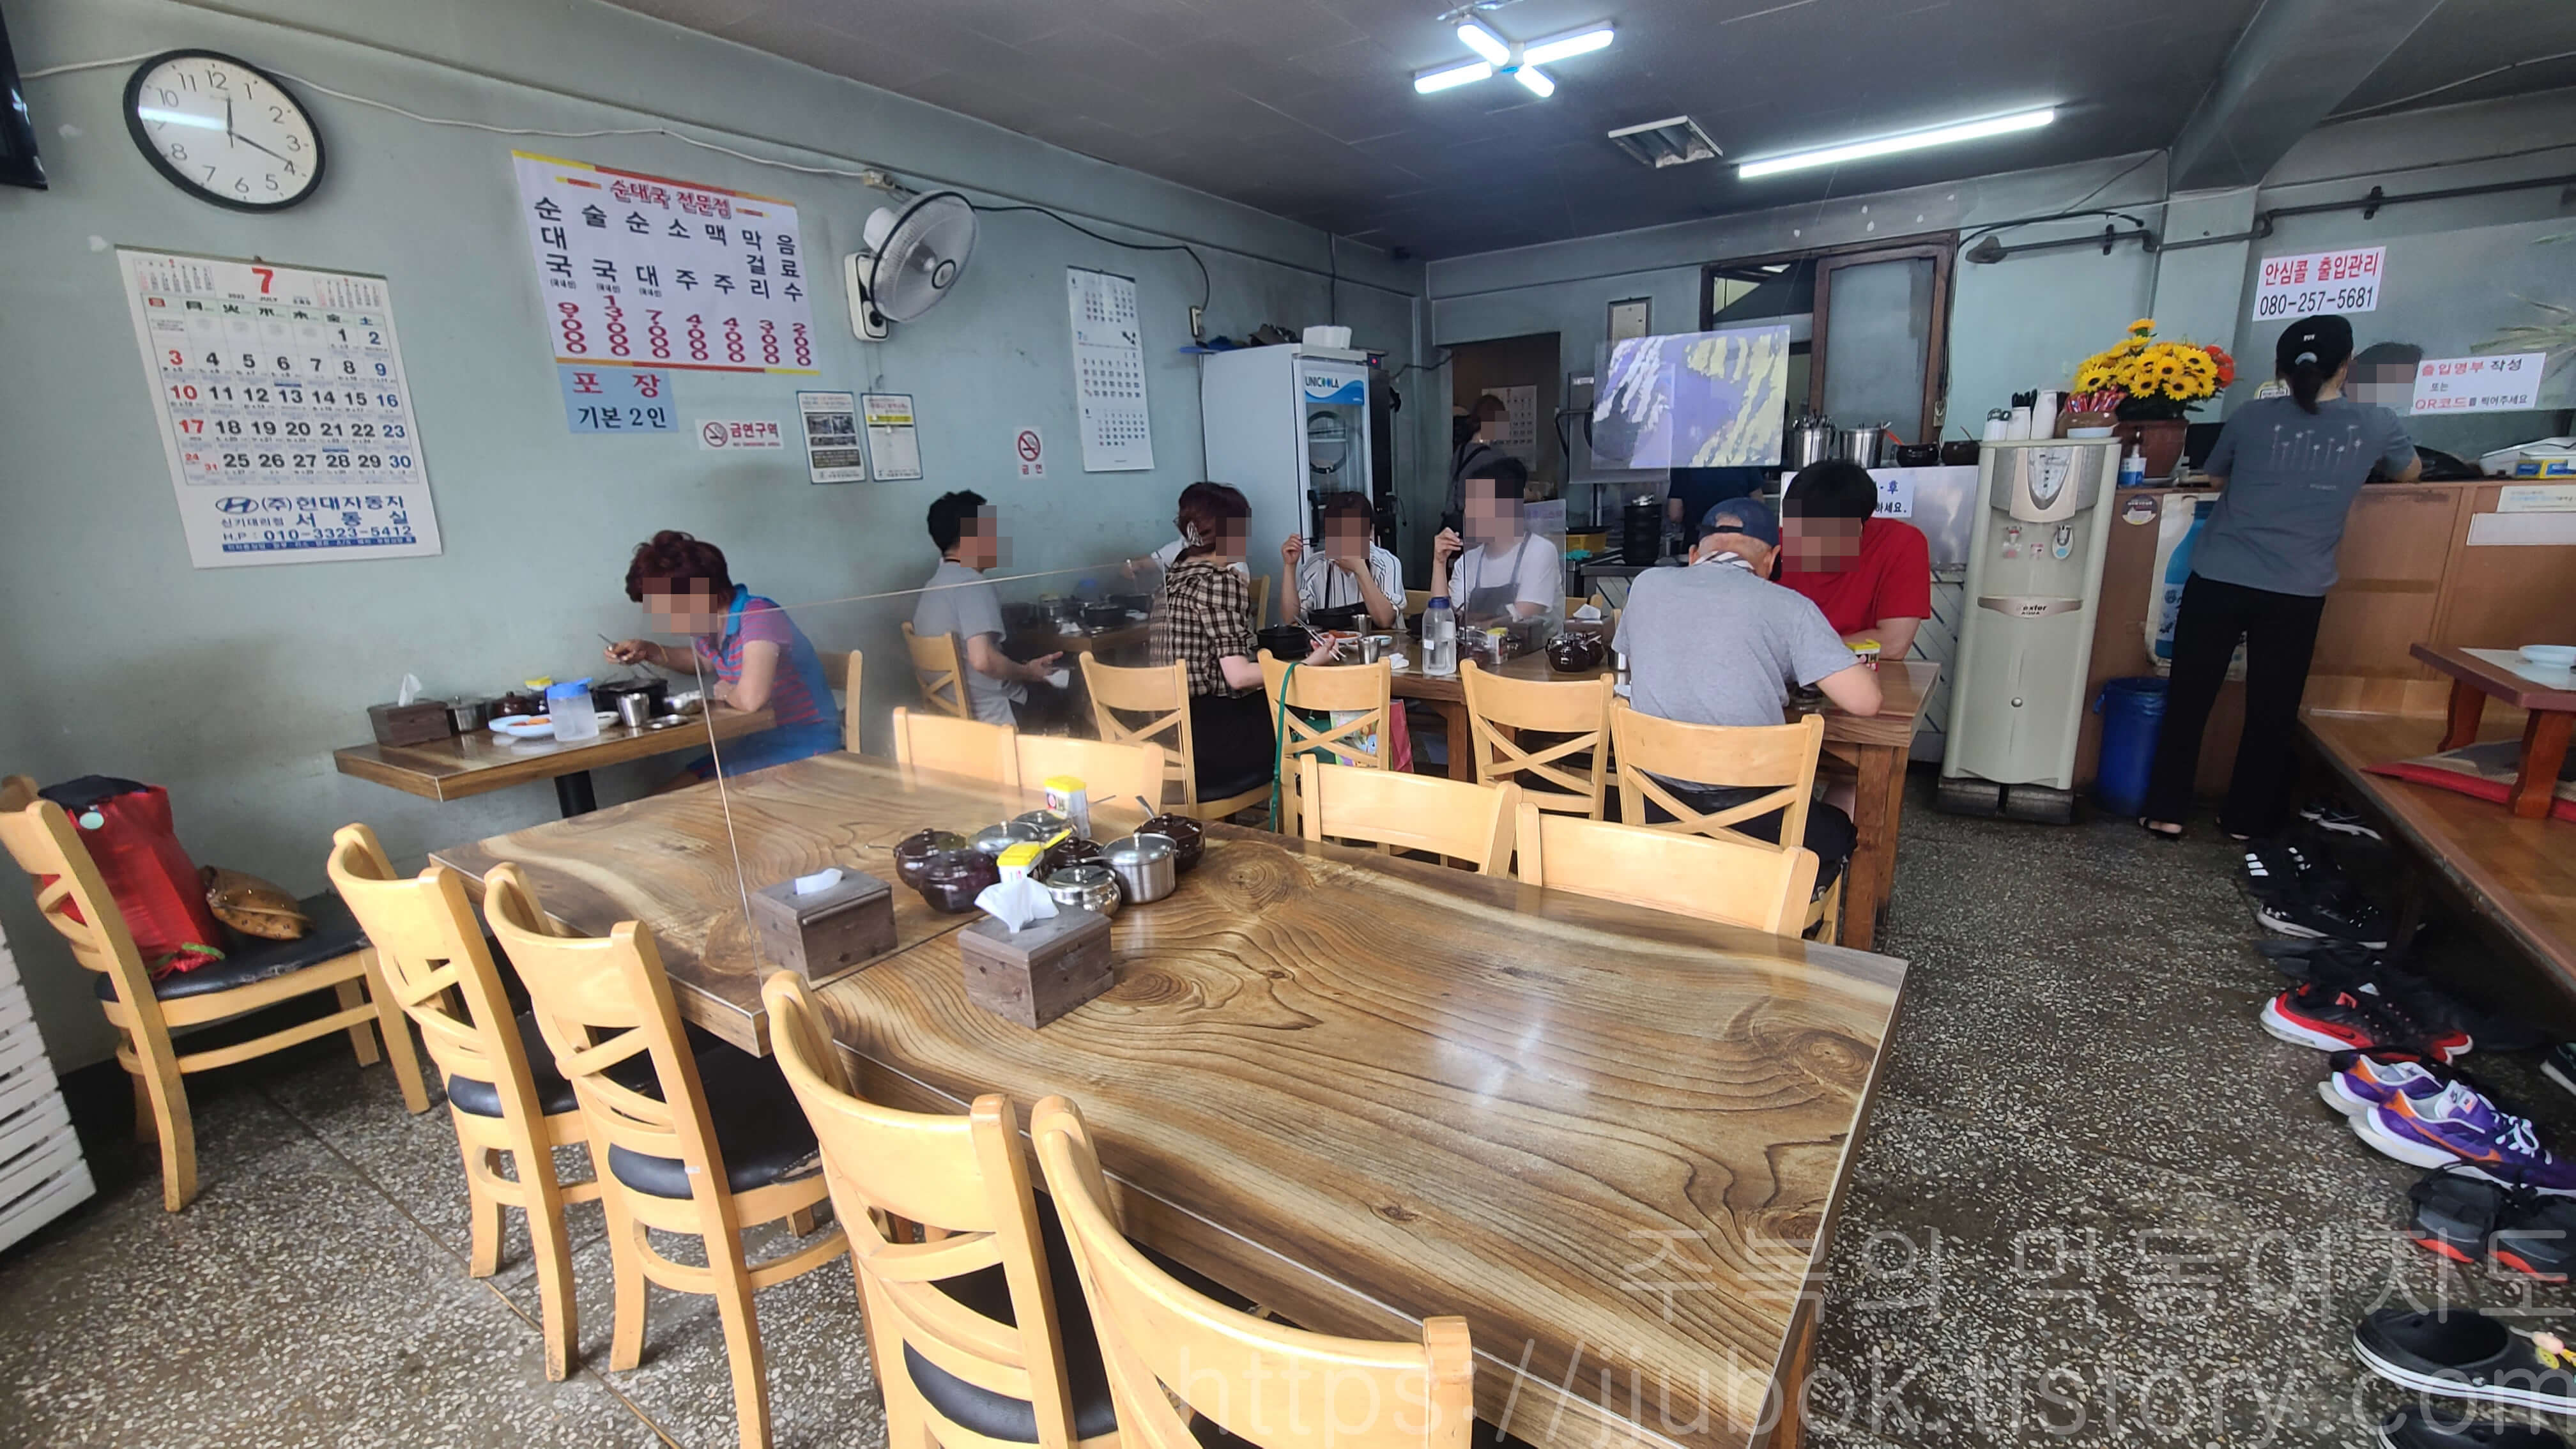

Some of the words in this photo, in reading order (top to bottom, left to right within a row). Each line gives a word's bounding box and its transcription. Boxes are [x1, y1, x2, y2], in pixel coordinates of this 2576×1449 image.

[178, 73, 197, 92] 11
[205, 70, 229, 90] 12
[157, 88, 179, 107] 10
[245, 83, 252, 100] 1
[270, 106, 284, 123] 2
[171, 143, 187, 160] 8
[286, 135, 301, 151] 3
[203, 165, 216, 181] 7
[284, 160, 295, 175] 4
[234, 177, 249, 193] 6
[266, 174, 279, 190] 5
[610, 180, 670, 210] 순대국
[677, 191, 732, 220] 전문점
[534, 197, 572, 279] 순대국
[742, 229, 770, 300] 막걸리
[776, 234, 803, 302] 음료수
[2266, 259, 2308, 286] 안심콜
[2317, 252, 2379, 281] 출입관리
[252, 267, 273, 294] 7
[2260, 286, 2373, 316] 080-257-5681
[338, 328, 347, 342] 1
[369, 331, 381, 345] 2
[169, 349, 183, 365] 3
[206, 352, 220, 366] 4
[243, 353, 256, 368] 5
[277, 356, 290, 371] 6
[310, 358, 321, 372] 7
[343, 360, 356, 374] 8
[374, 362, 387, 376] 9
[2421, 361, 2484, 376] 출입명부
[2490, 357, 2522, 372] 작성
[2429, 381, 2448, 392] 또는
[170, 385, 197, 400] 10
[209, 386, 233, 401] 11
[243, 388, 270, 402] 12
[279, 389, 303, 403] 13
[312, 390, 335, 404] 14
[344, 392, 367, 406] 15
[376, 393, 399, 408] 16
[2415, 397, 2477, 410] QR코드를
[2481, 394, 2527, 408] 찍어주세요
[578, 407, 622, 429] 기본
[179, 418, 204, 434] 17
[215, 420, 241, 434] 18
[251, 420, 276, 435] 19
[285, 422, 310, 436] 20
[320, 422, 342, 436] 21
[351, 424, 376, 437] 22
[383, 424, 405, 438] 23
[730, 422, 779, 438] 금연구역
[185, 452, 199, 461] 24
[224, 453, 250, 468] 25
[259, 454, 285, 468] 26
[293, 454, 316, 468] 27
[326, 454, 351, 468] 28
[358, 455, 381, 468] 29
[389, 455, 411, 468] 30
[264, 526, 411, 541] 010-3323-5412
